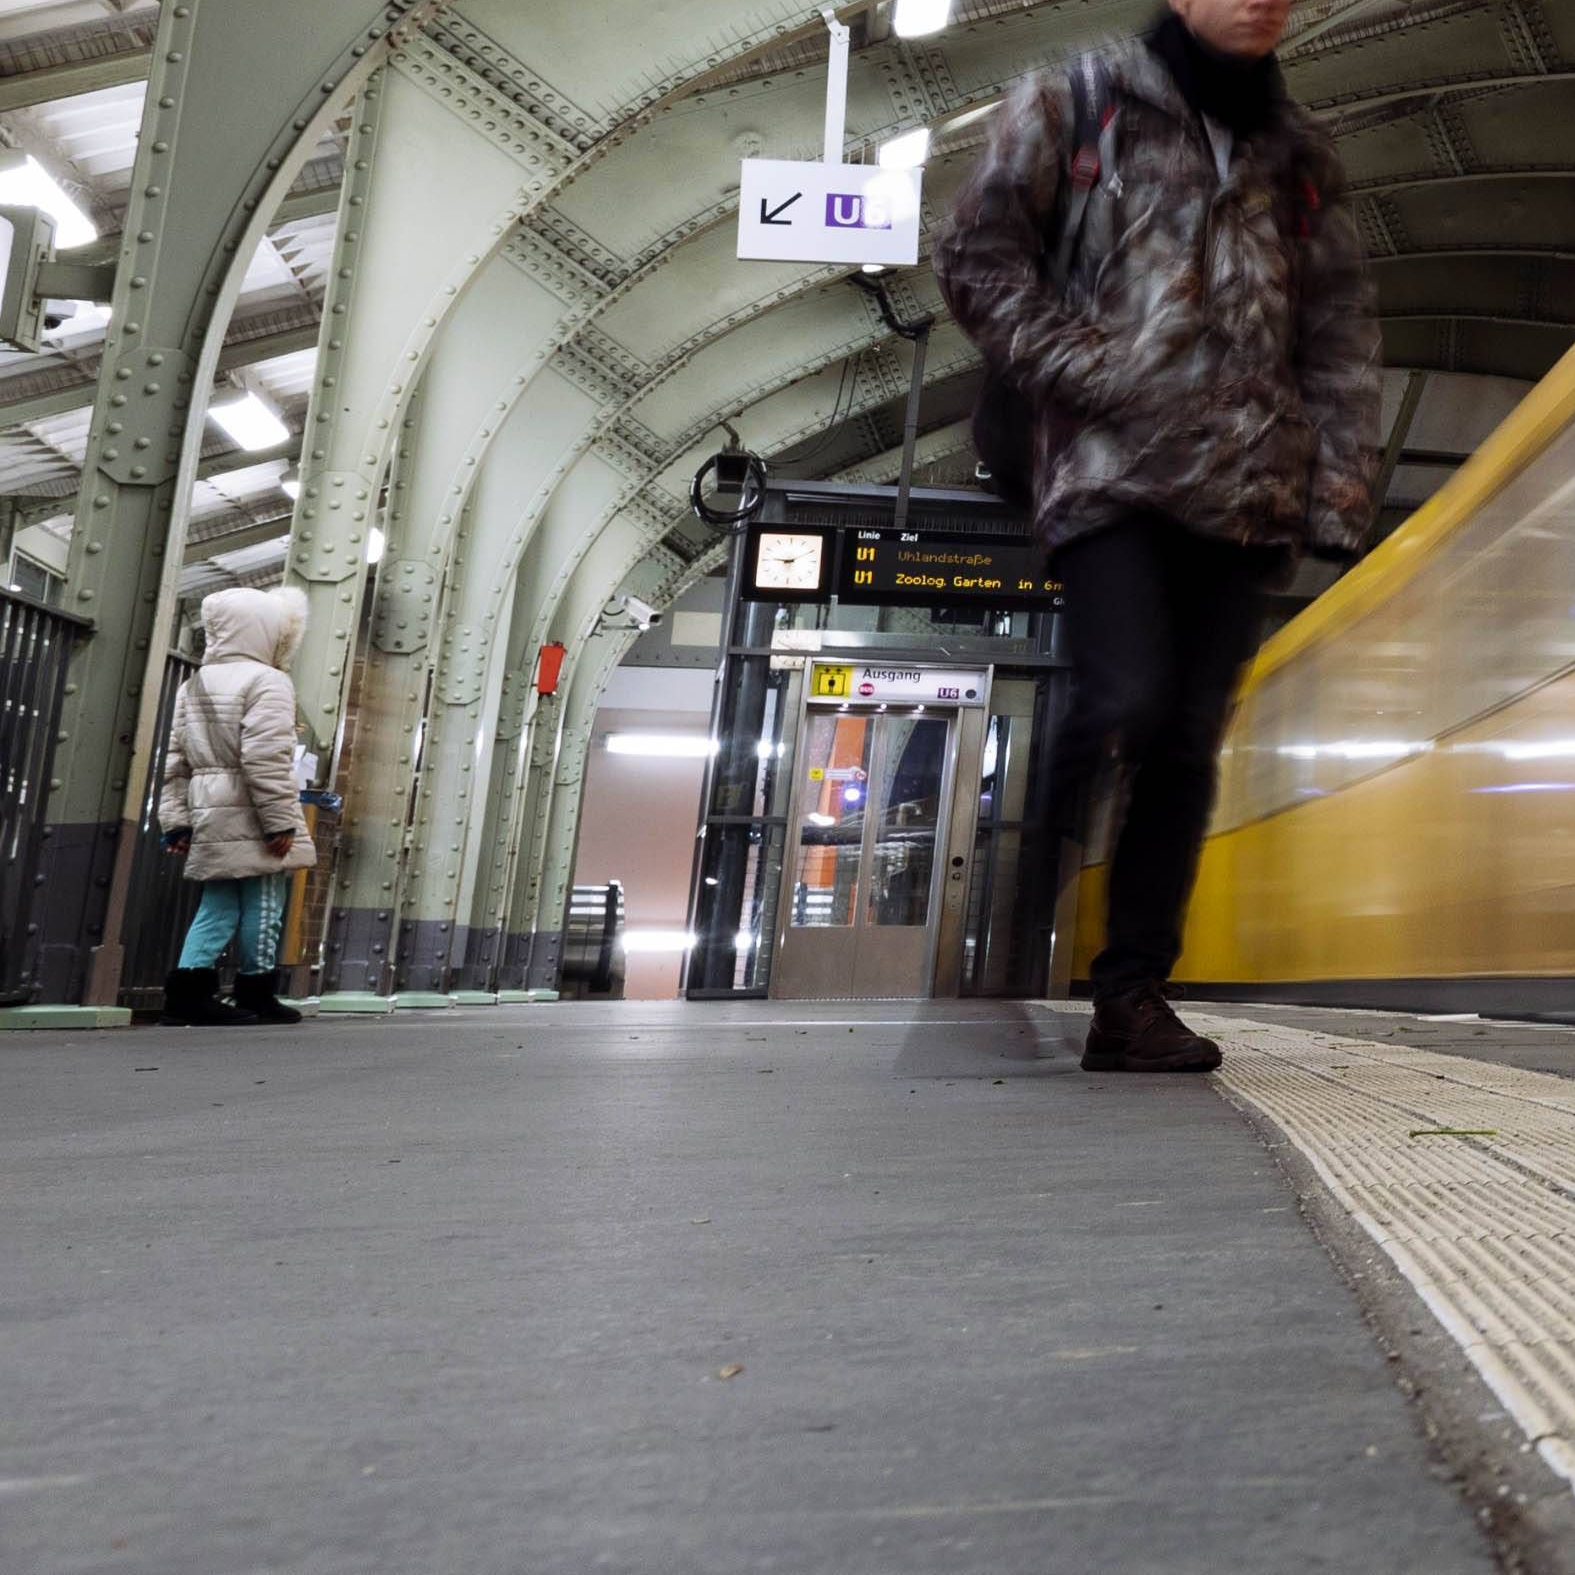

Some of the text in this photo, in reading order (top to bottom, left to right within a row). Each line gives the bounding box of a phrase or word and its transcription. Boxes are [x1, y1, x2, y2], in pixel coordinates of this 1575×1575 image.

[858, 530, 881, 541] Linie
[901, 532, 919, 543] Ziel
[857, 547, 992, 567] U1 Uhlandstraße
[854, 570, 873, 585] U1
[953, 576, 1001, 589] Garten
[1018, 580, 1032, 591] in
[862, 668, 921, 682] Ausgang
[940, 688, 957, 699] U6
